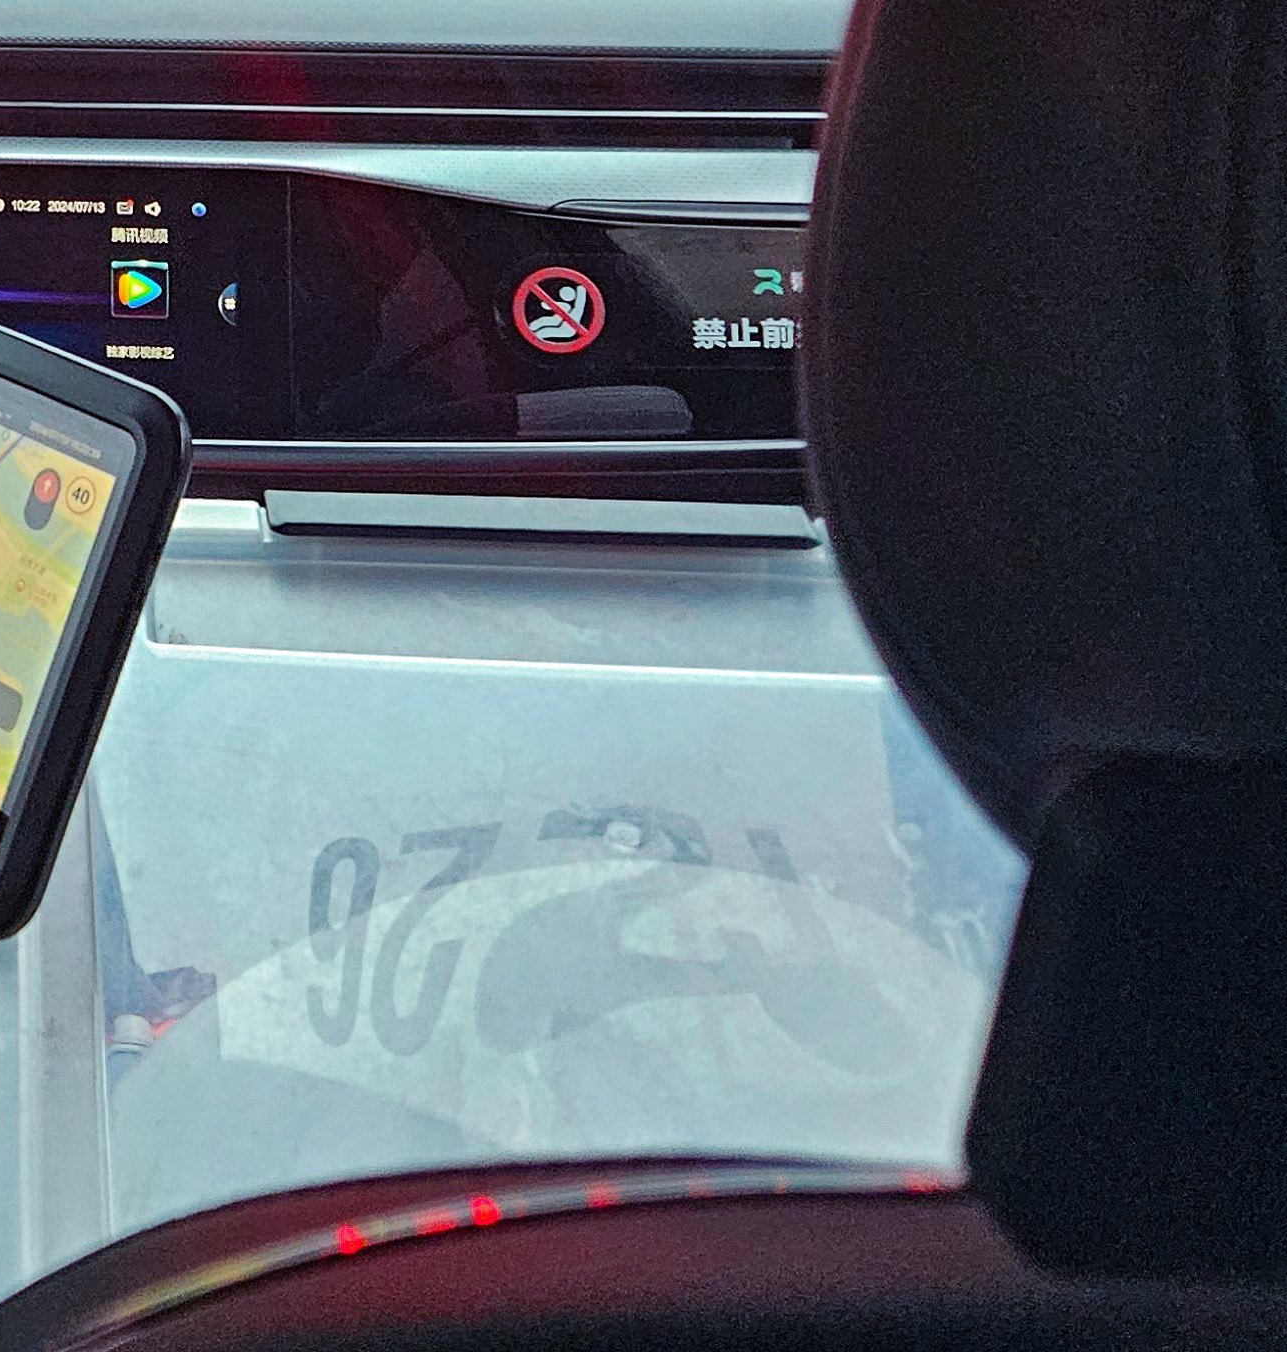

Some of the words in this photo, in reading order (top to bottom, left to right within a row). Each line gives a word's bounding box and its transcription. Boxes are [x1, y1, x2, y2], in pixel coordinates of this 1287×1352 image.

[11, 199, 41, 212] 10:22
[47, 200, 106, 214] 2024/07/13
[692, 316, 802, 349] 禁止前
[71, 486, 90, 505] 40
